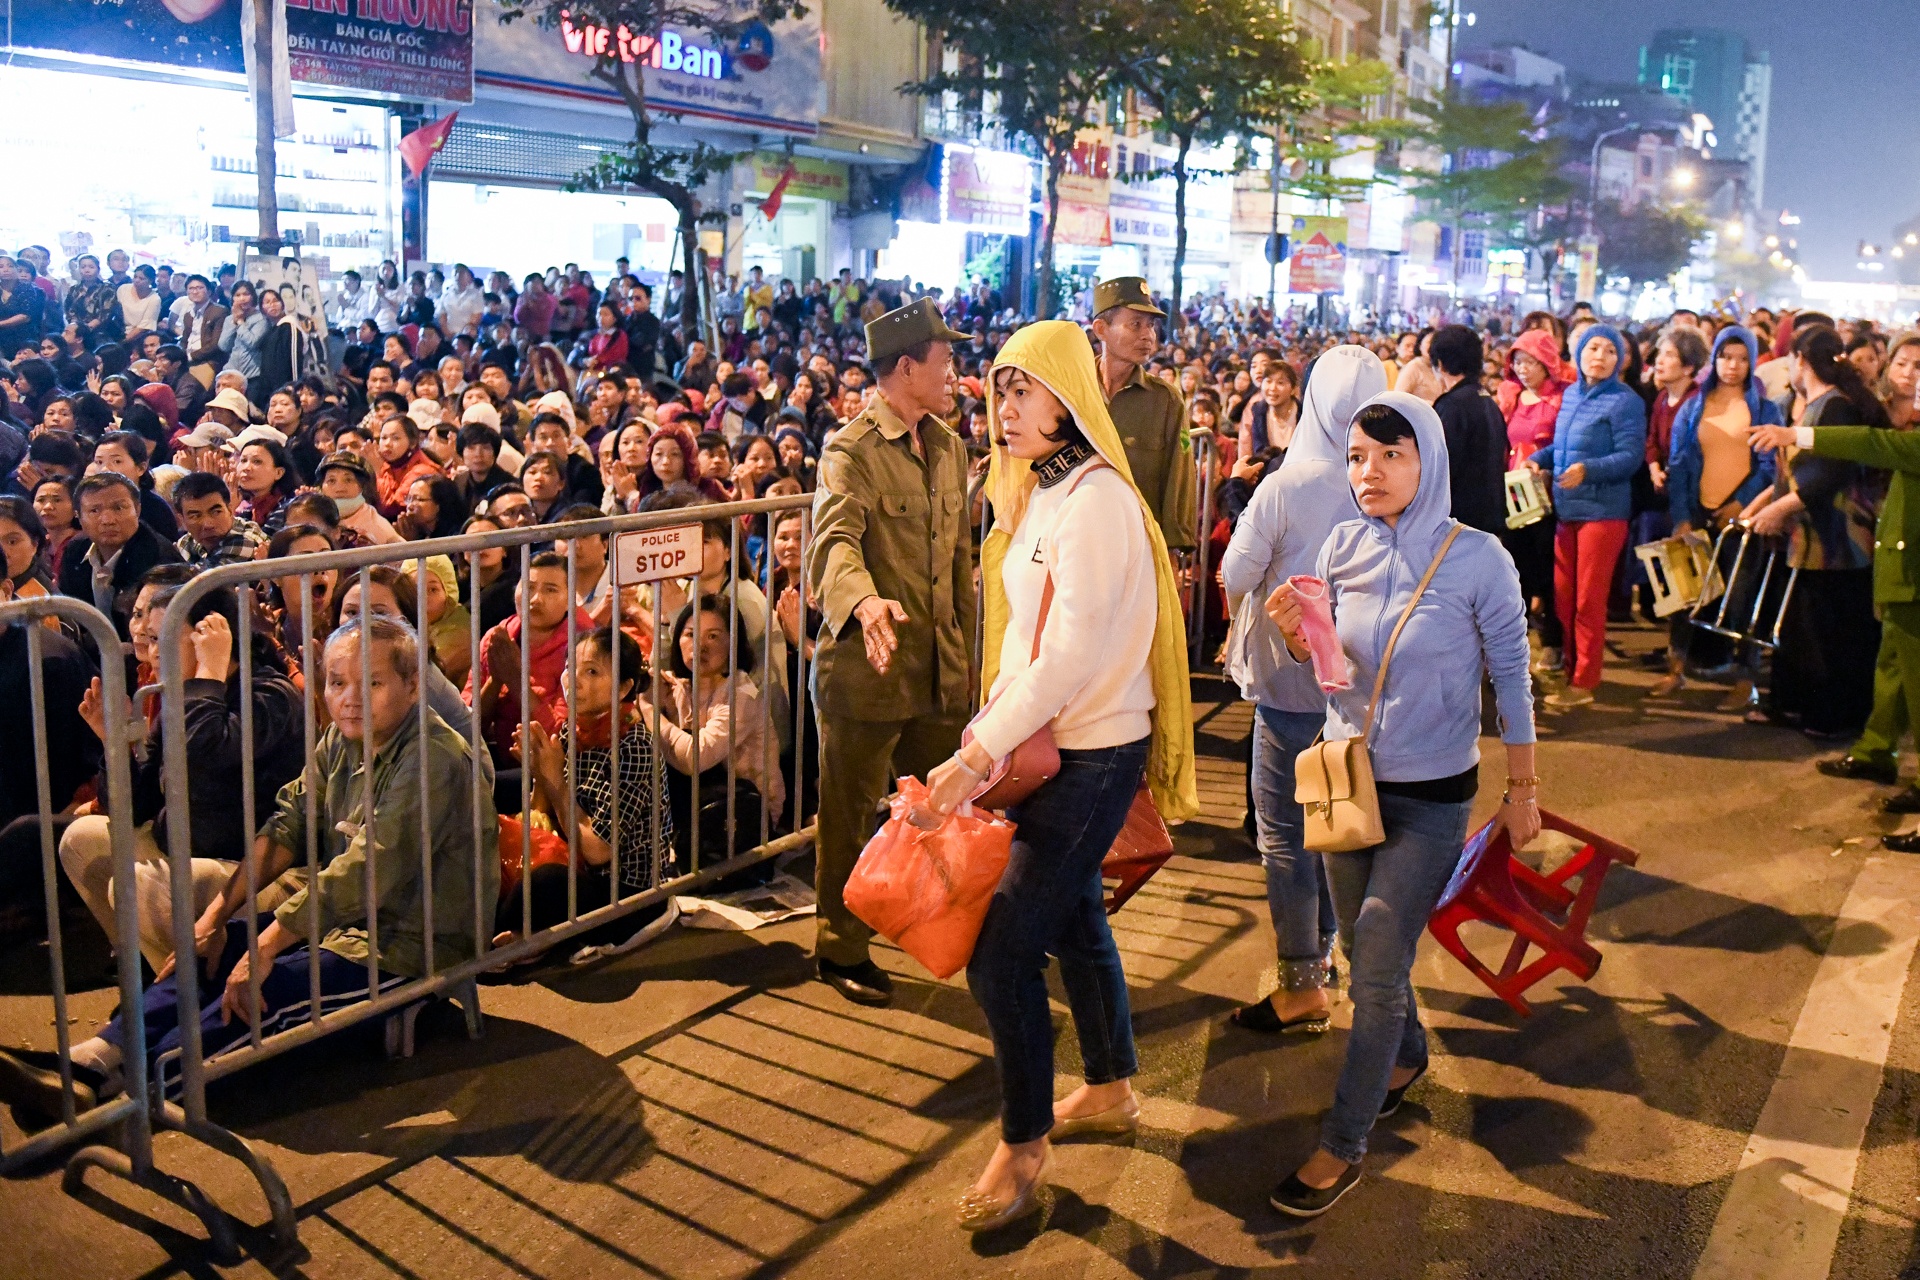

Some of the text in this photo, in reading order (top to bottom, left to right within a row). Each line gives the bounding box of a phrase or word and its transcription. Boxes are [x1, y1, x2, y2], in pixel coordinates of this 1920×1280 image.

[336, 22, 425, 49] BÁN GIÁ GỐC
[641, 533, 680, 547] POLICE
[636, 550, 686, 573] STOP
